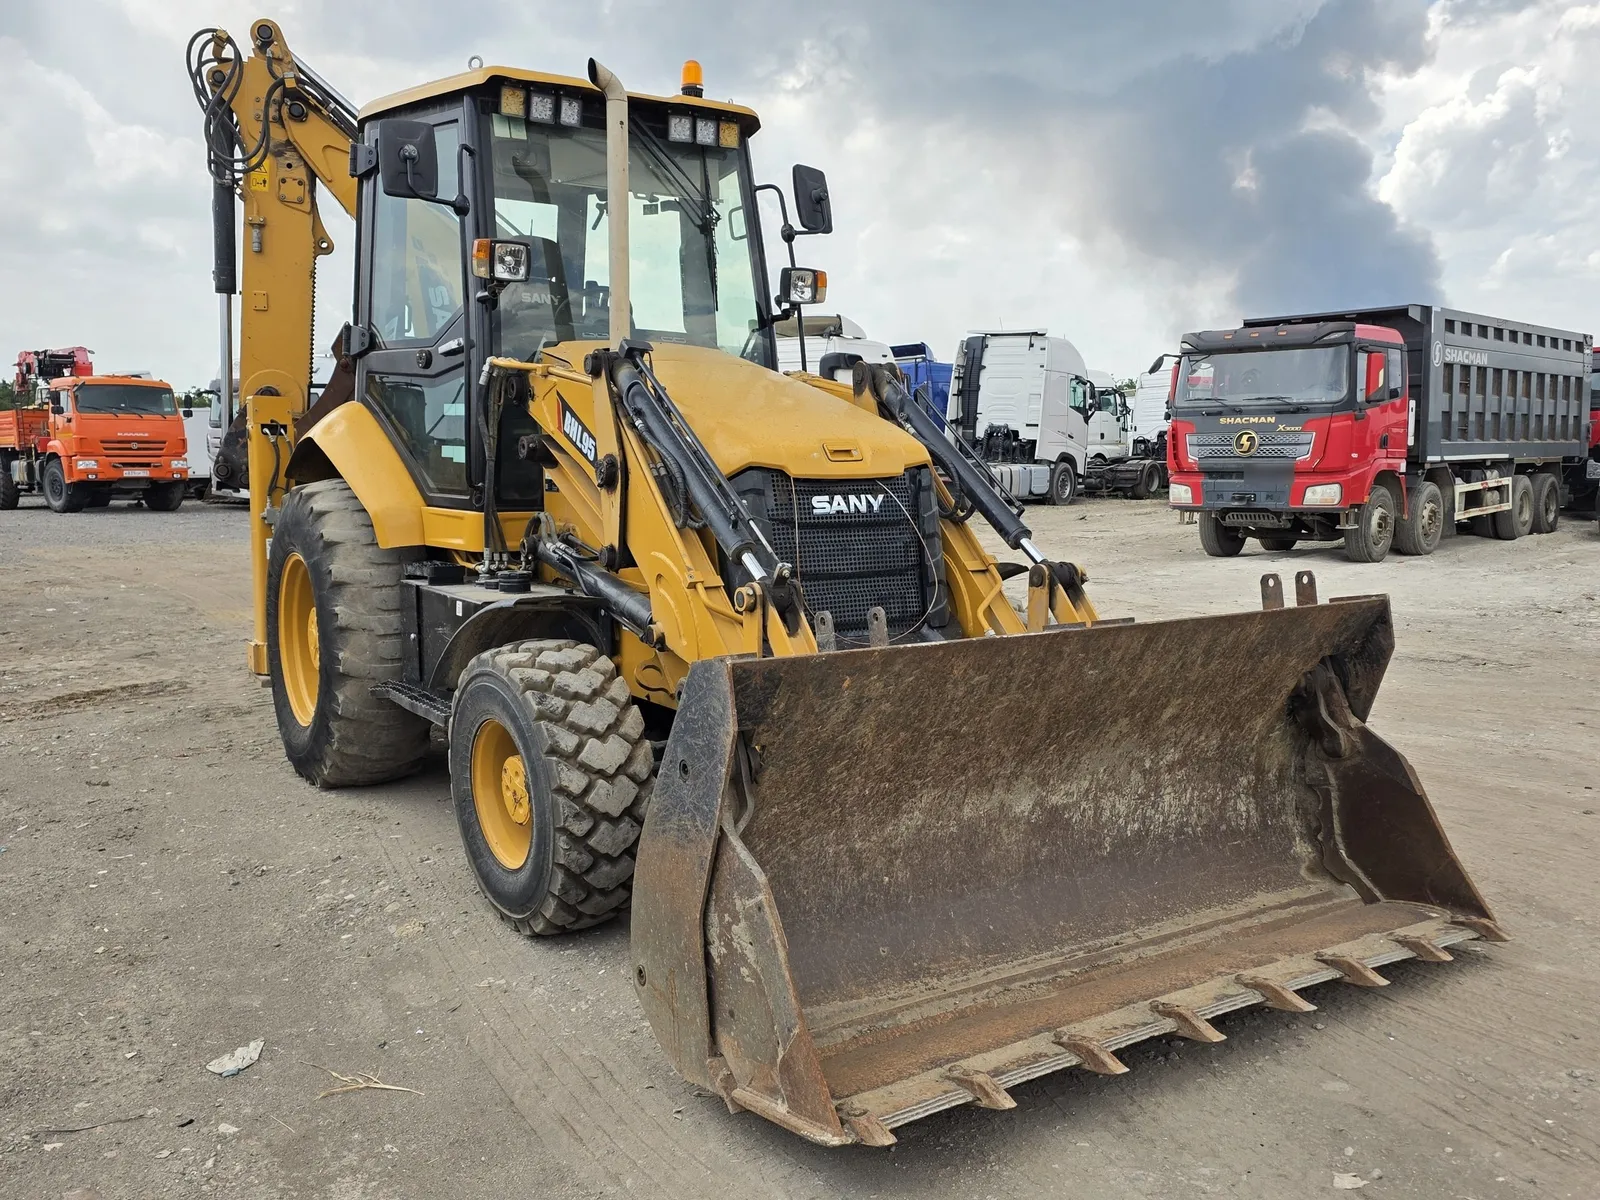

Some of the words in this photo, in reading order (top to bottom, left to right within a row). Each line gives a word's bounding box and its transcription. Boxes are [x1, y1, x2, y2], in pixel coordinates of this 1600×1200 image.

[1445, 347, 1488, 365] SHACMAN
[1219, 416, 1276, 425] SHACMAN
[563, 410, 596, 462] BHL95
[811, 493, 884, 515] SANY
